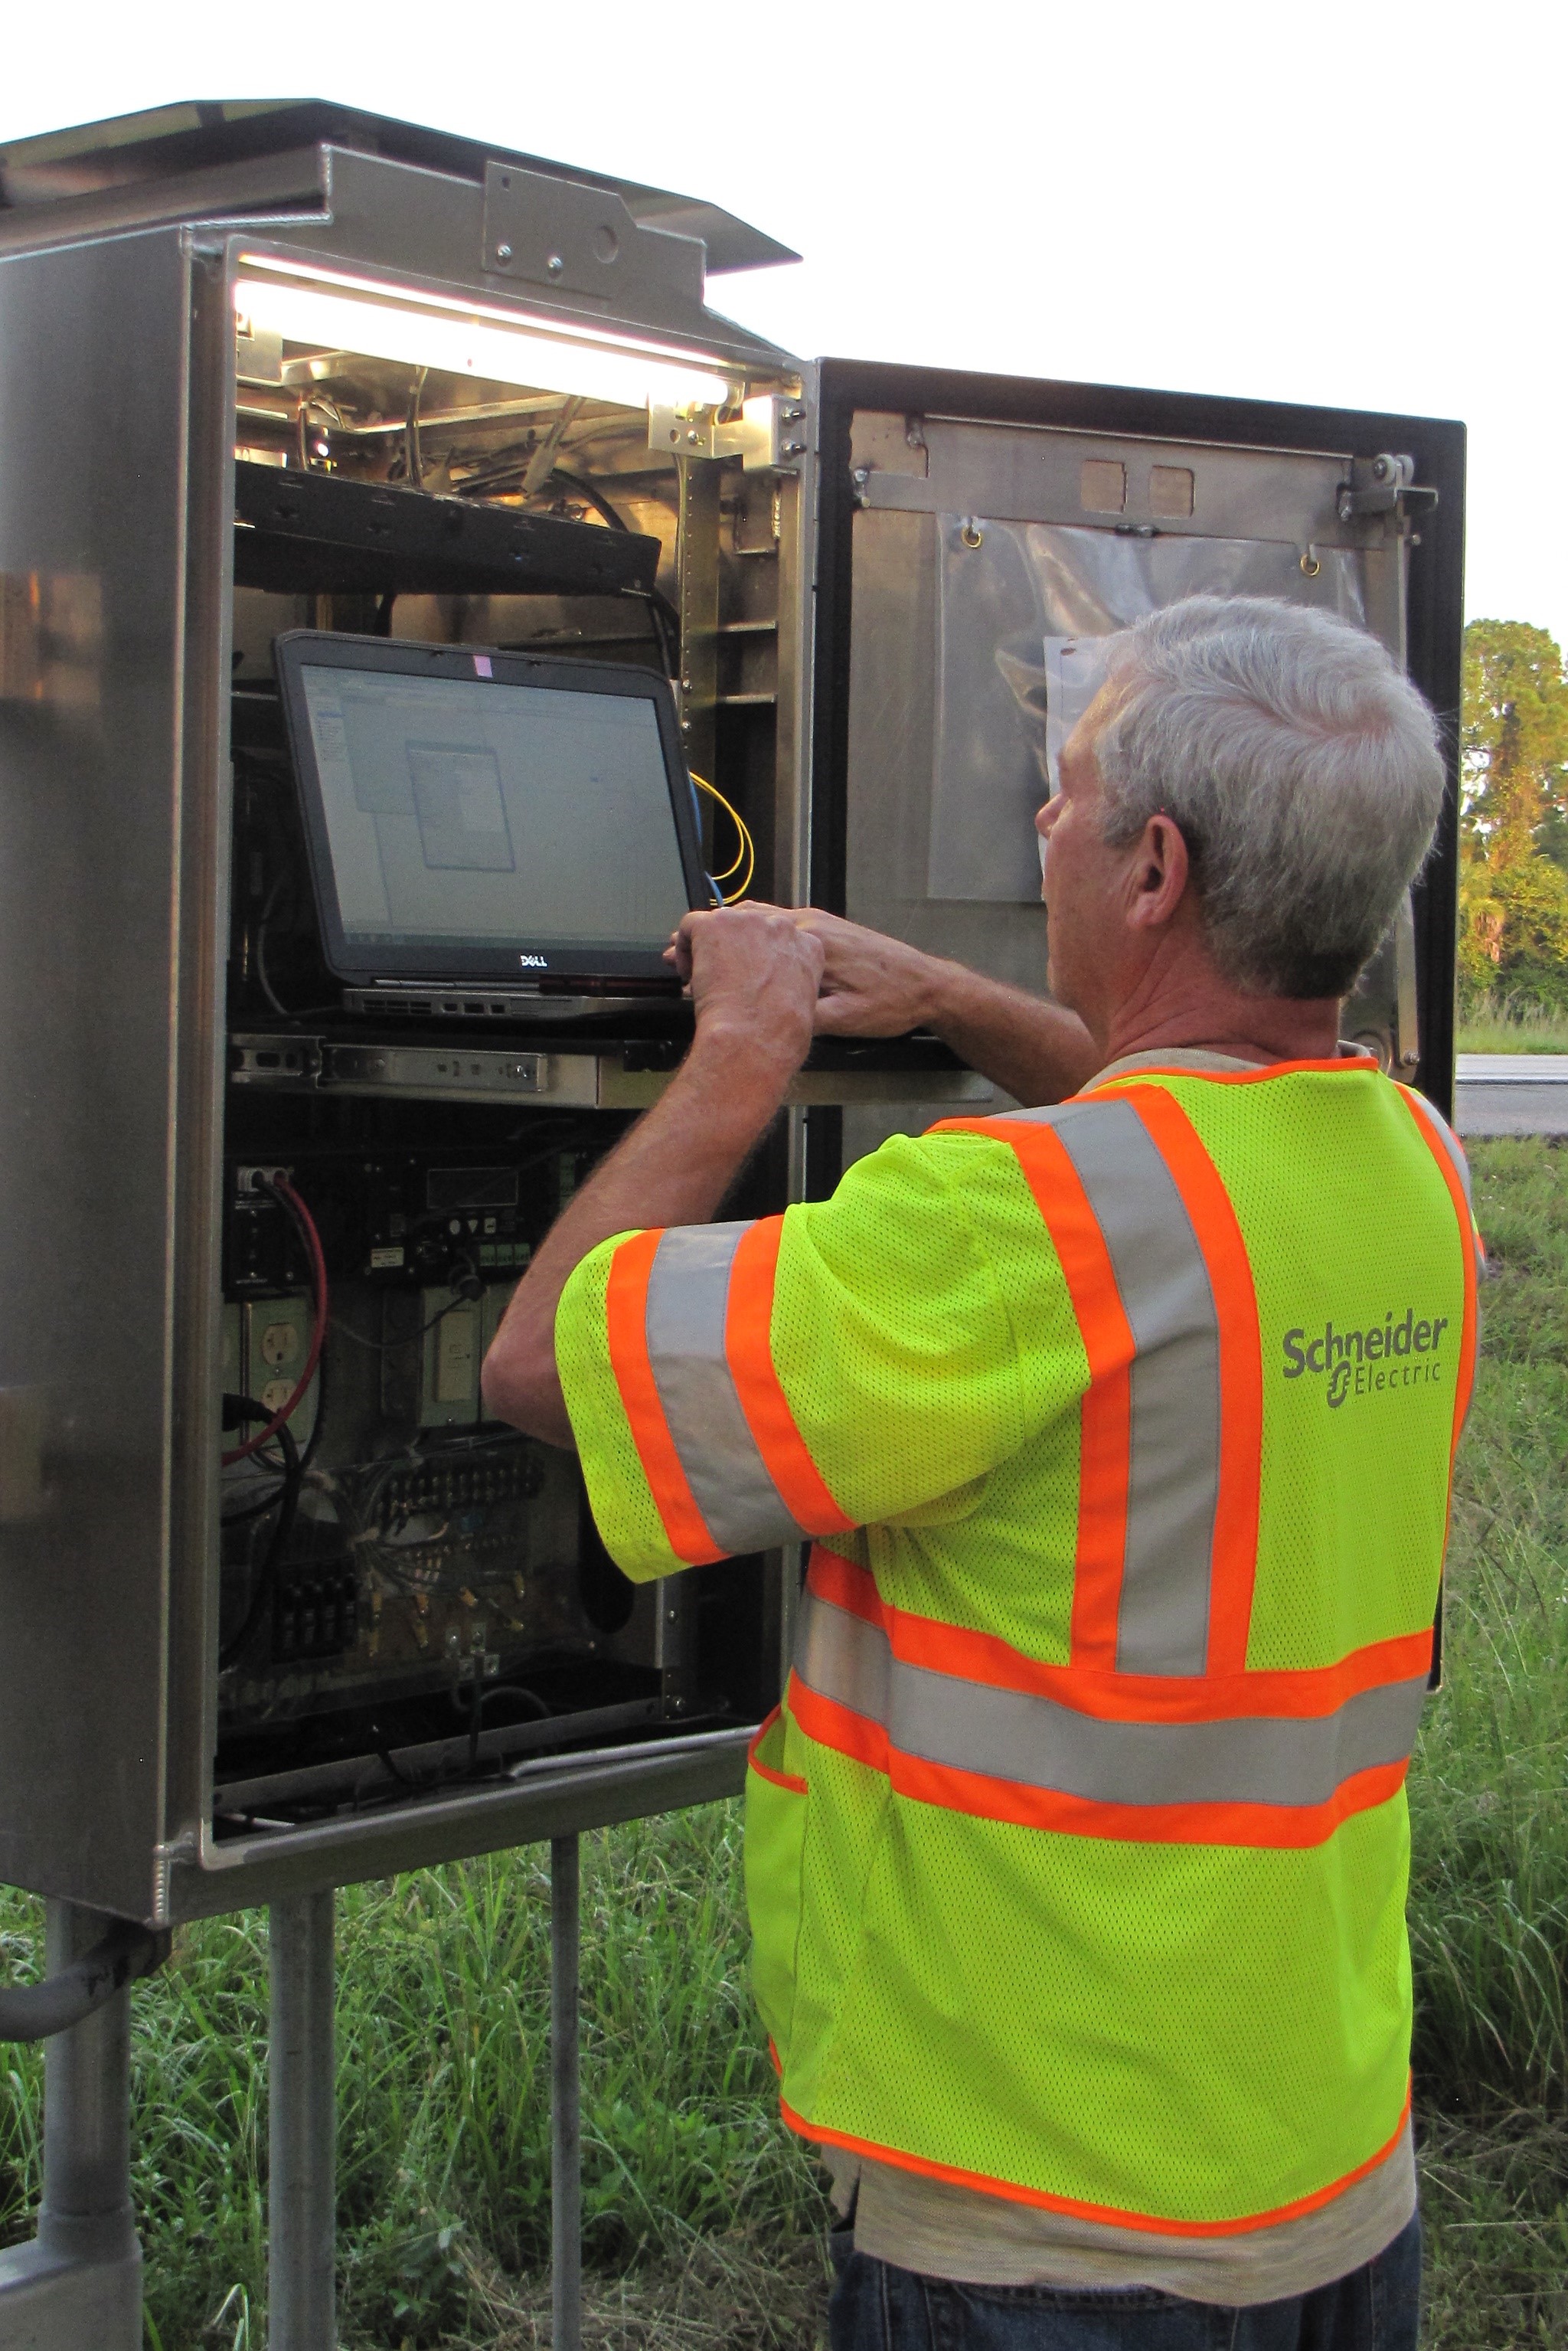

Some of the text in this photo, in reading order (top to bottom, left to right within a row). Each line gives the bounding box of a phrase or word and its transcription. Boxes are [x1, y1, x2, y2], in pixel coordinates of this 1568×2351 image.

[521, 955, 547, 966] DELL
[1282, 1308, 1448, 1378] Schneider
[1354, 1358, 1441, 1395] Electric
